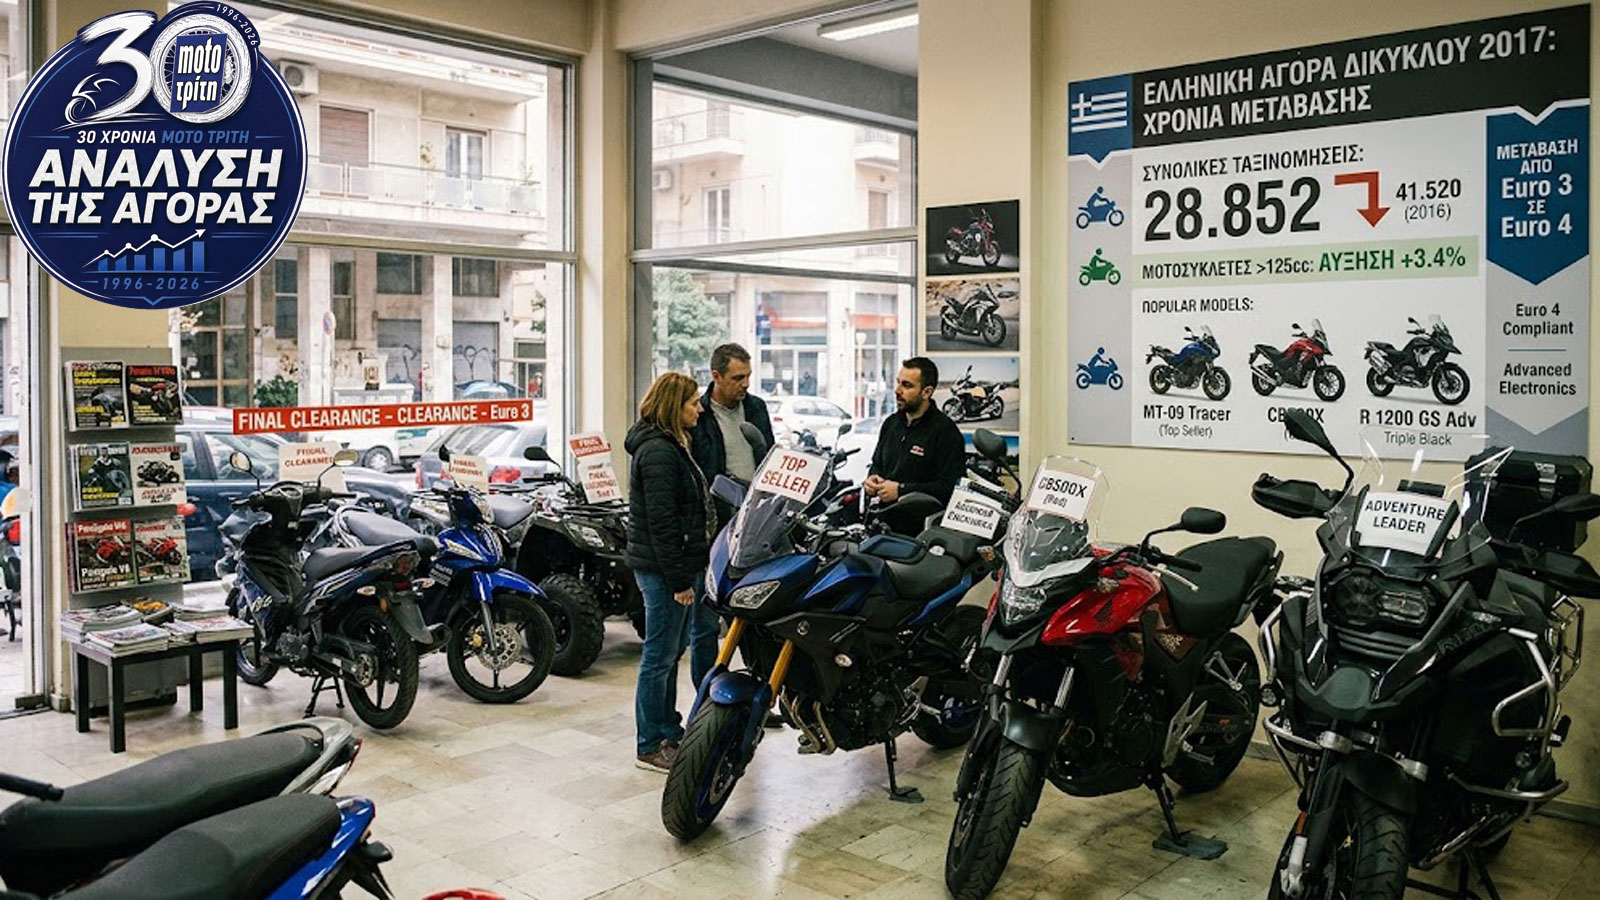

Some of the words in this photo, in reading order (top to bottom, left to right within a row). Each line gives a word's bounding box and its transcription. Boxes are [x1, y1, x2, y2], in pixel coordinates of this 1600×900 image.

[1143, 68, 1253, 106] ΕΛΛΗΝΙΚΗ
[1260, 56, 1337, 90] ΑΓΟΡΑ
[1344, 35, 1472, 78] ΔΙΚΥΚΛΟΥ
[1479, 25, 1556, 60] 2017:
[1143, 104, 1224, 136] ΧΡΟΝΙΑ
[1231, 85, 1372, 126] ΜΕΤΑΒΑΣΗΣ
[1143, 157, 1228, 182] ΣΥΝΟΛΙΚΕΣ
[1233, 144, 1364, 174] ΤΑΞΙΝΟΜΗΣΕΙΣ:
[1520, 158, 1553, 175] ΑΠΟ
[1395, 178, 1462, 201] 41.520
[1501, 177, 1551, 199] Euro
[1557, 173, 1573, 196] 3
[1145, 177, 1321, 242] 28.852
[1404, 203, 1452, 223] (2016)
[1527, 200, 1546, 215] ΣΕ
[1501, 216, 1551, 238] Euro
[1557, 213, 1573, 235] 4
[1142, 259, 1252, 279] ΜΟΤΟΣΥΚΛΕΤΕΣ
[1256, 258, 1314, 275] >125cc:
[1319, 249, 1394, 272] ΑΥΞΗΣΗ
[1401, 246, 1466, 269] +3.4%
[1200, 297, 1254, 312] MODELS:
[1516, 303, 1547, 317] Euro
[1551, 302, 1561, 317] 4
[1503, 321, 1574, 338] Compliant
[1503, 362, 1572, 377] Advanced
[1499, 381, 1577, 395] Electronics
[238, 411, 286, 431] FINAL
[290, 408, 381, 429] CLEARANCE
[397, 404, 477, 424] CLEARANCE
[521, 403, 530, 418] 3
[1143, 404, 1184, 419] MT-09
[1188, 405, 1231, 421] Tracer
[1268, 407, 1325, 423] CB0X
[1360, 409, 1370, 424] R
[1376, 410, 1413, 426] 1200
[1419, 410, 1441, 427] GS
[1446, 411, 1477, 428] Adv
[1182, 424, 1213, 439] Seller)
[1384, 431, 1416, 446] Triple
[1419, 432, 1452, 446] Black
[780, 455, 808, 473] TOP
[761, 469, 811, 495] SELLER
[1037, 476, 1088, 499] CB500X
[1365, 500, 1445, 521] ADVENTURE
[1373, 516, 1427, 534] LEADER
